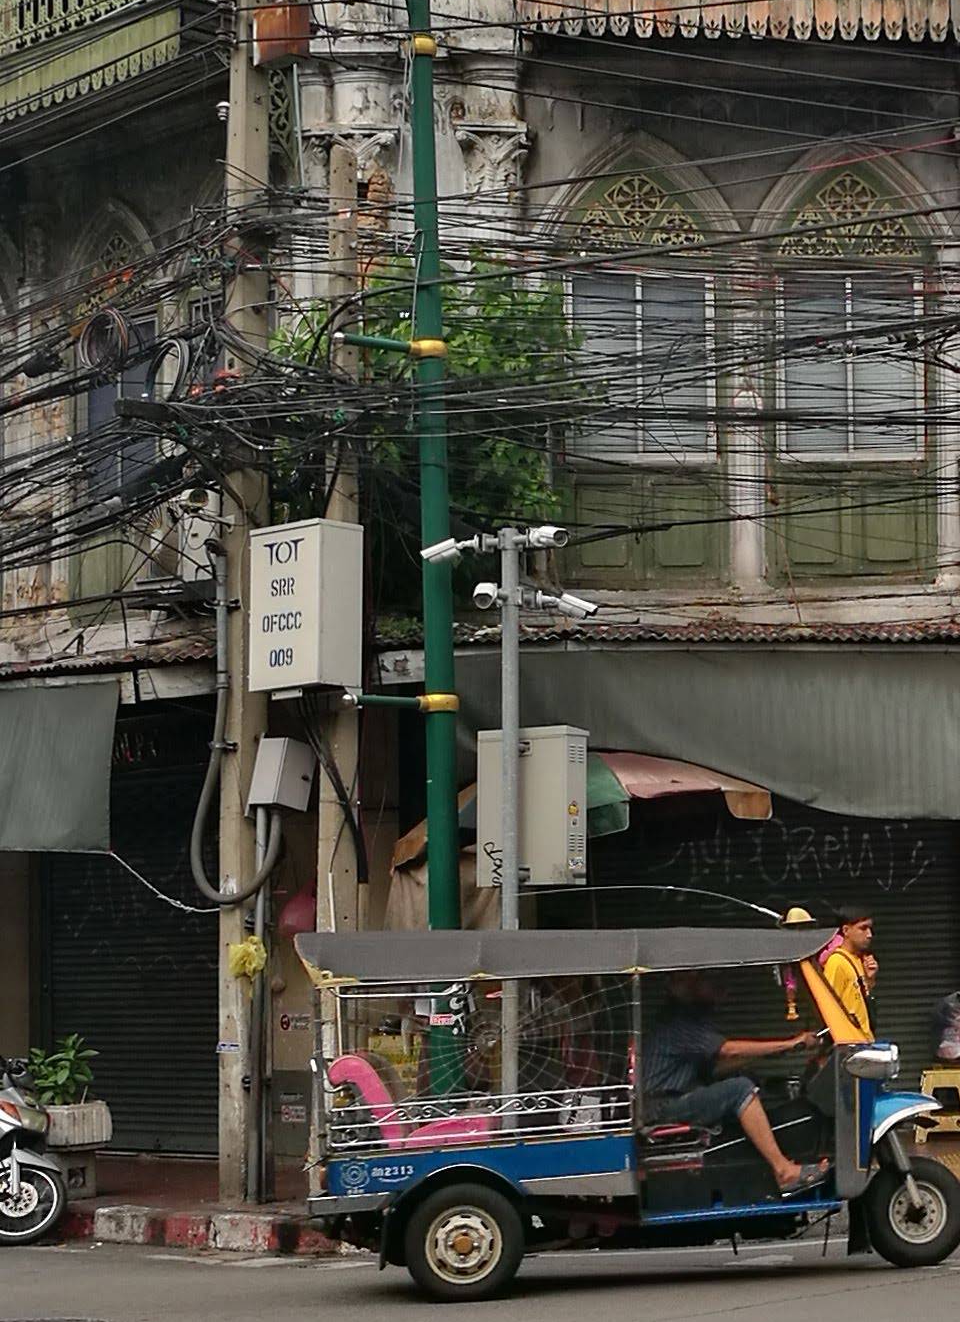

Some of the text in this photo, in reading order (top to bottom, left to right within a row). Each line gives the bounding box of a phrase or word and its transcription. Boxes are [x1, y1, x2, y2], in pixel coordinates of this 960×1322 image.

[263, 538, 305, 565] TOT
[270, 577, 295, 597] SRR
[269, 648, 294, 668] 009
